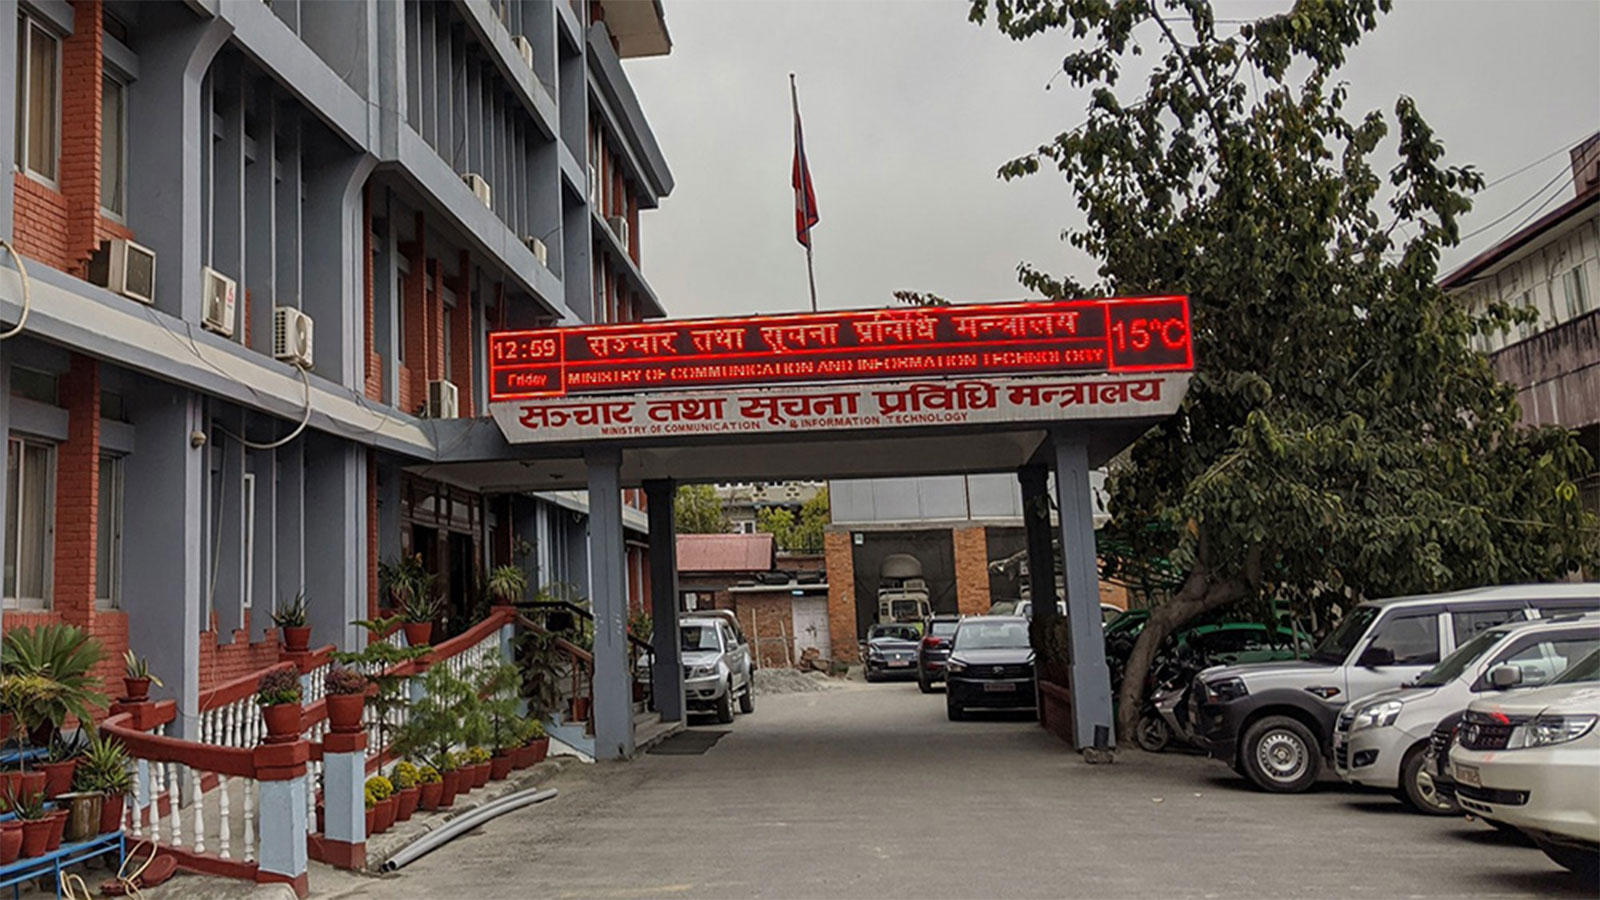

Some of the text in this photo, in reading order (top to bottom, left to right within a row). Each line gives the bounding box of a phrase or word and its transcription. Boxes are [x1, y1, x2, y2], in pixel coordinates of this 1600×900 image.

[587, 331, 678, 357] सञ्चार
[690, 328, 746, 350] तथा
[760, 323, 839, 353] सूचना
[951, 311, 1079, 338] मन्त्रालय
[493, 338, 556, 360] 12:59
[817, 359, 853, 374] AND
[507, 372, 548, 387] Friday
[519, 378, 1165, 429] सञ्चार तथा सूचना प्रविधि मन्त्रालय
[601, 411, 969, 435] MINISTRY OF COMMUNICATION & INFORMATION TECHNOLOGY
